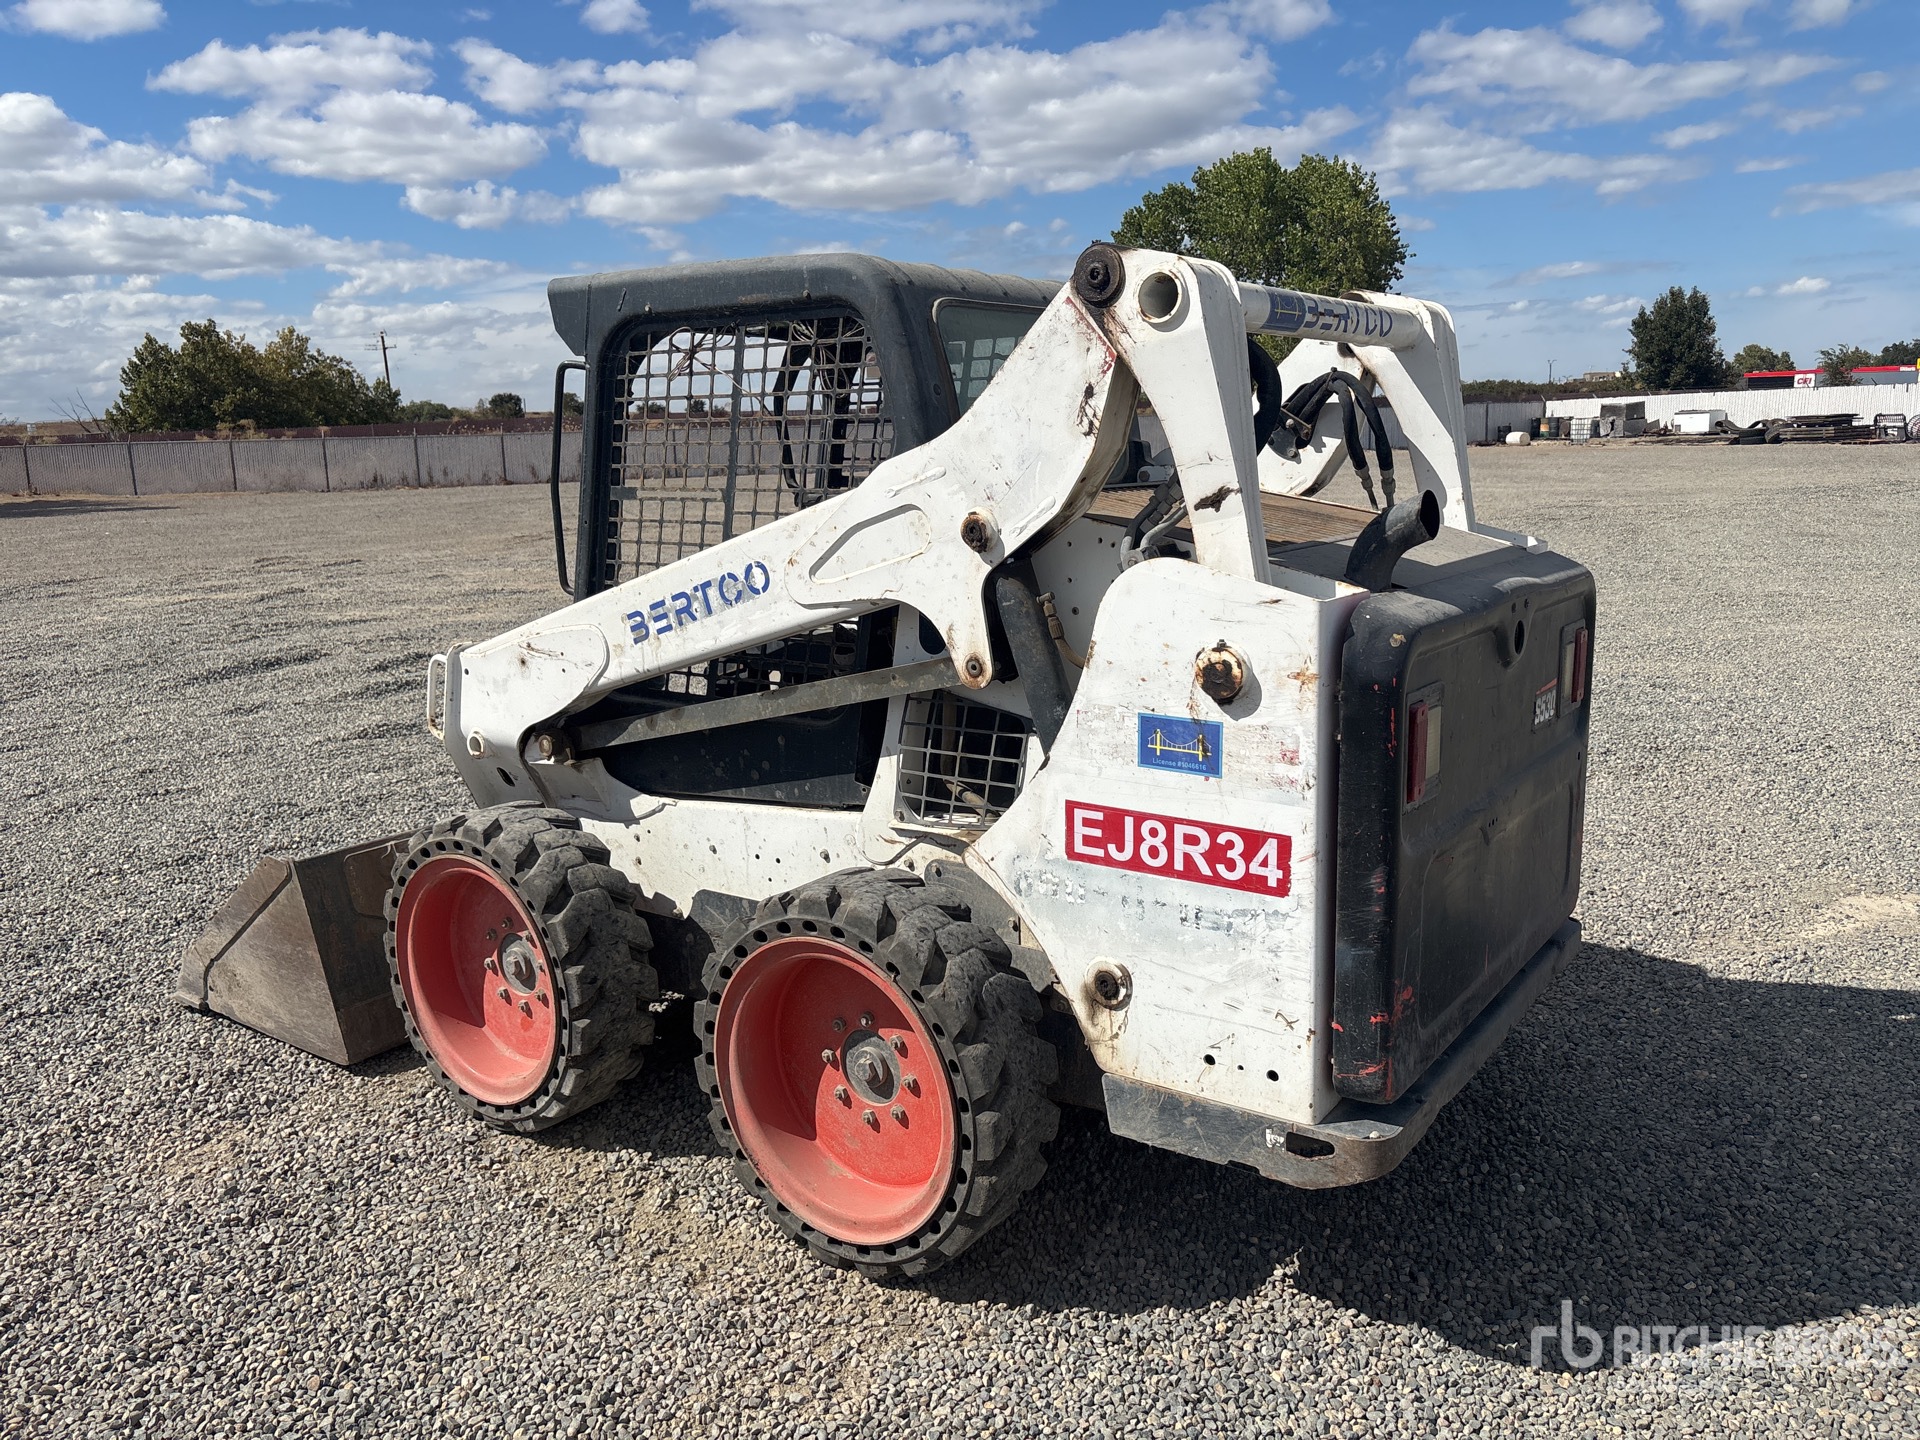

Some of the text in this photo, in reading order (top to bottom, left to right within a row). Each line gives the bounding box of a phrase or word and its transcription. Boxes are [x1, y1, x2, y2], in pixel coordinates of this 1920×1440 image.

[626, 560, 771, 646] BERTCO
[1152, 757, 1177, 767] License
[1073, 807, 1284, 888] EJ8R34
